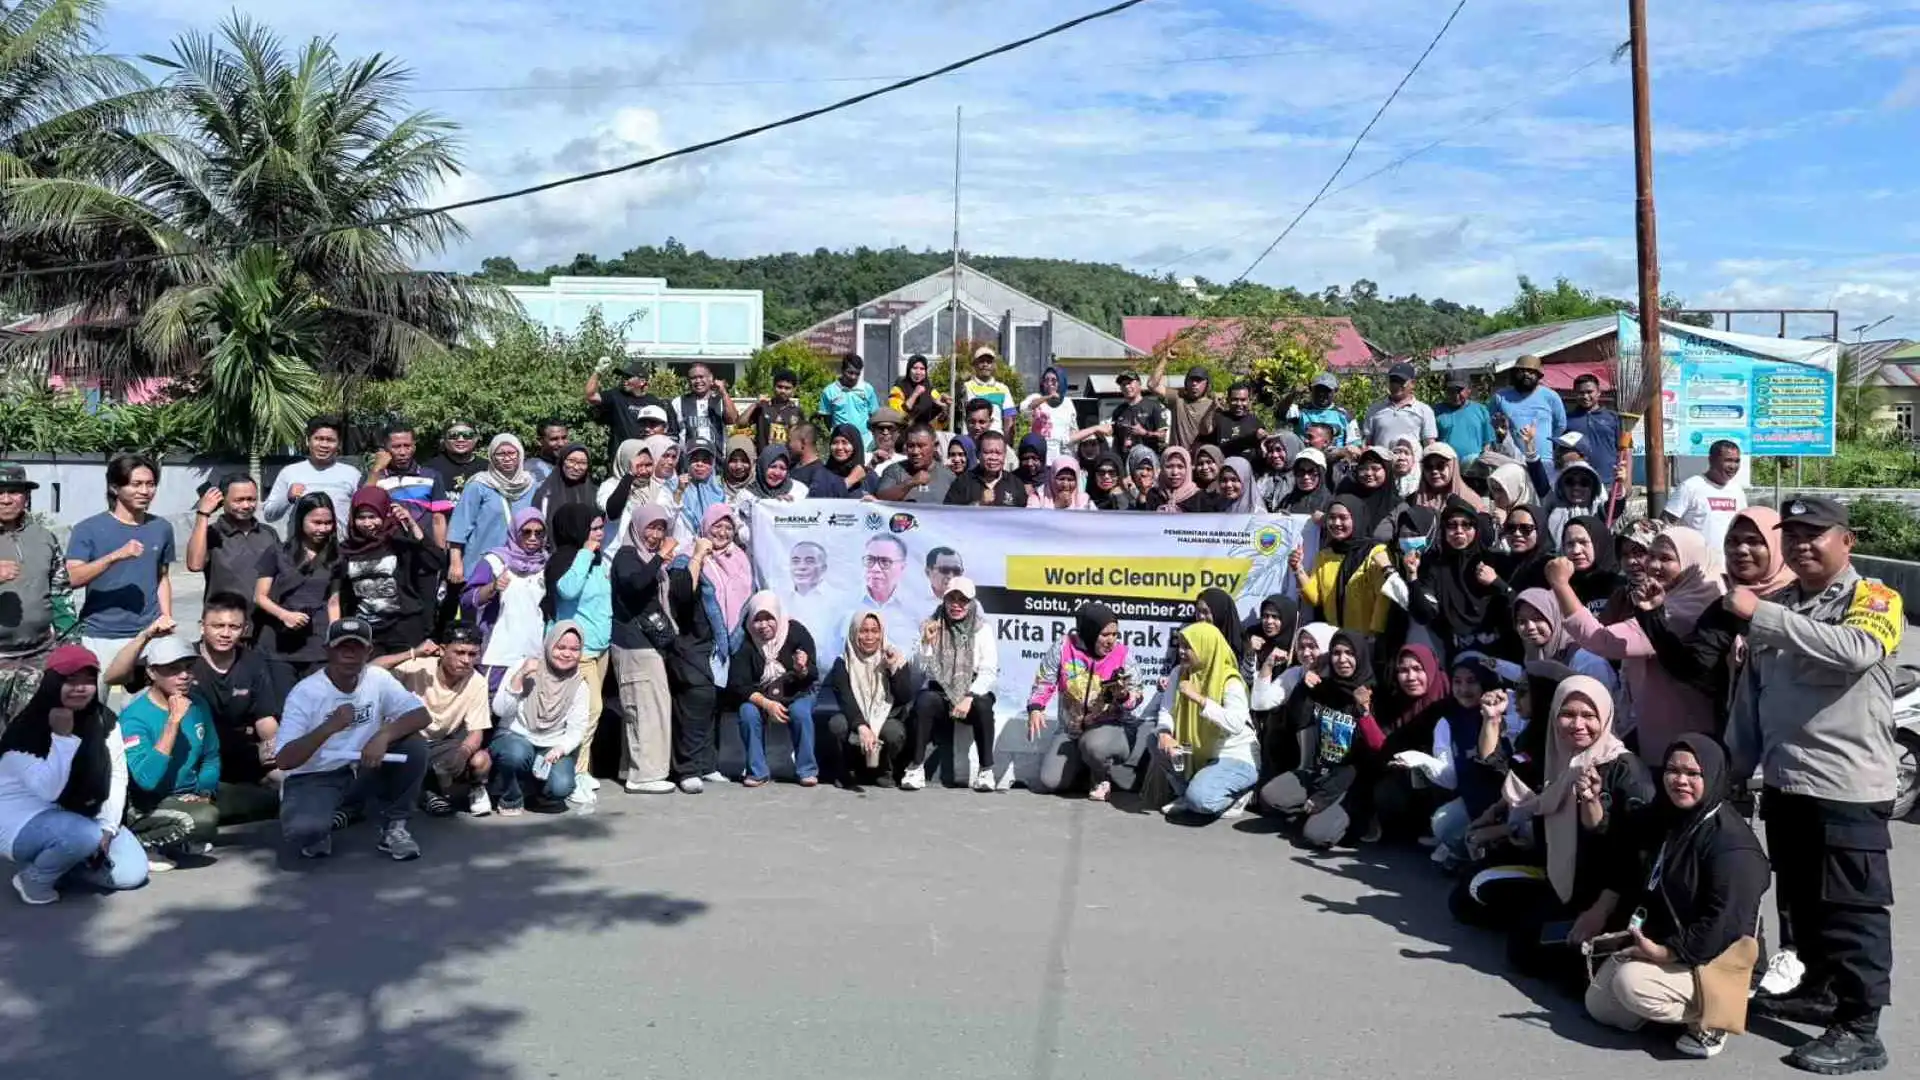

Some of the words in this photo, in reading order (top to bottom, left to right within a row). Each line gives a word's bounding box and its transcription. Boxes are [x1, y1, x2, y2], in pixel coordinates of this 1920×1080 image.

[1044, 567, 1104, 586] World
[1109, 568, 1196, 593] Cleanup
[1200, 570, 1241, 592] Day
[1024, 597, 1072, 614] Sabtu,
[997, 618, 1044, 641] Kita
